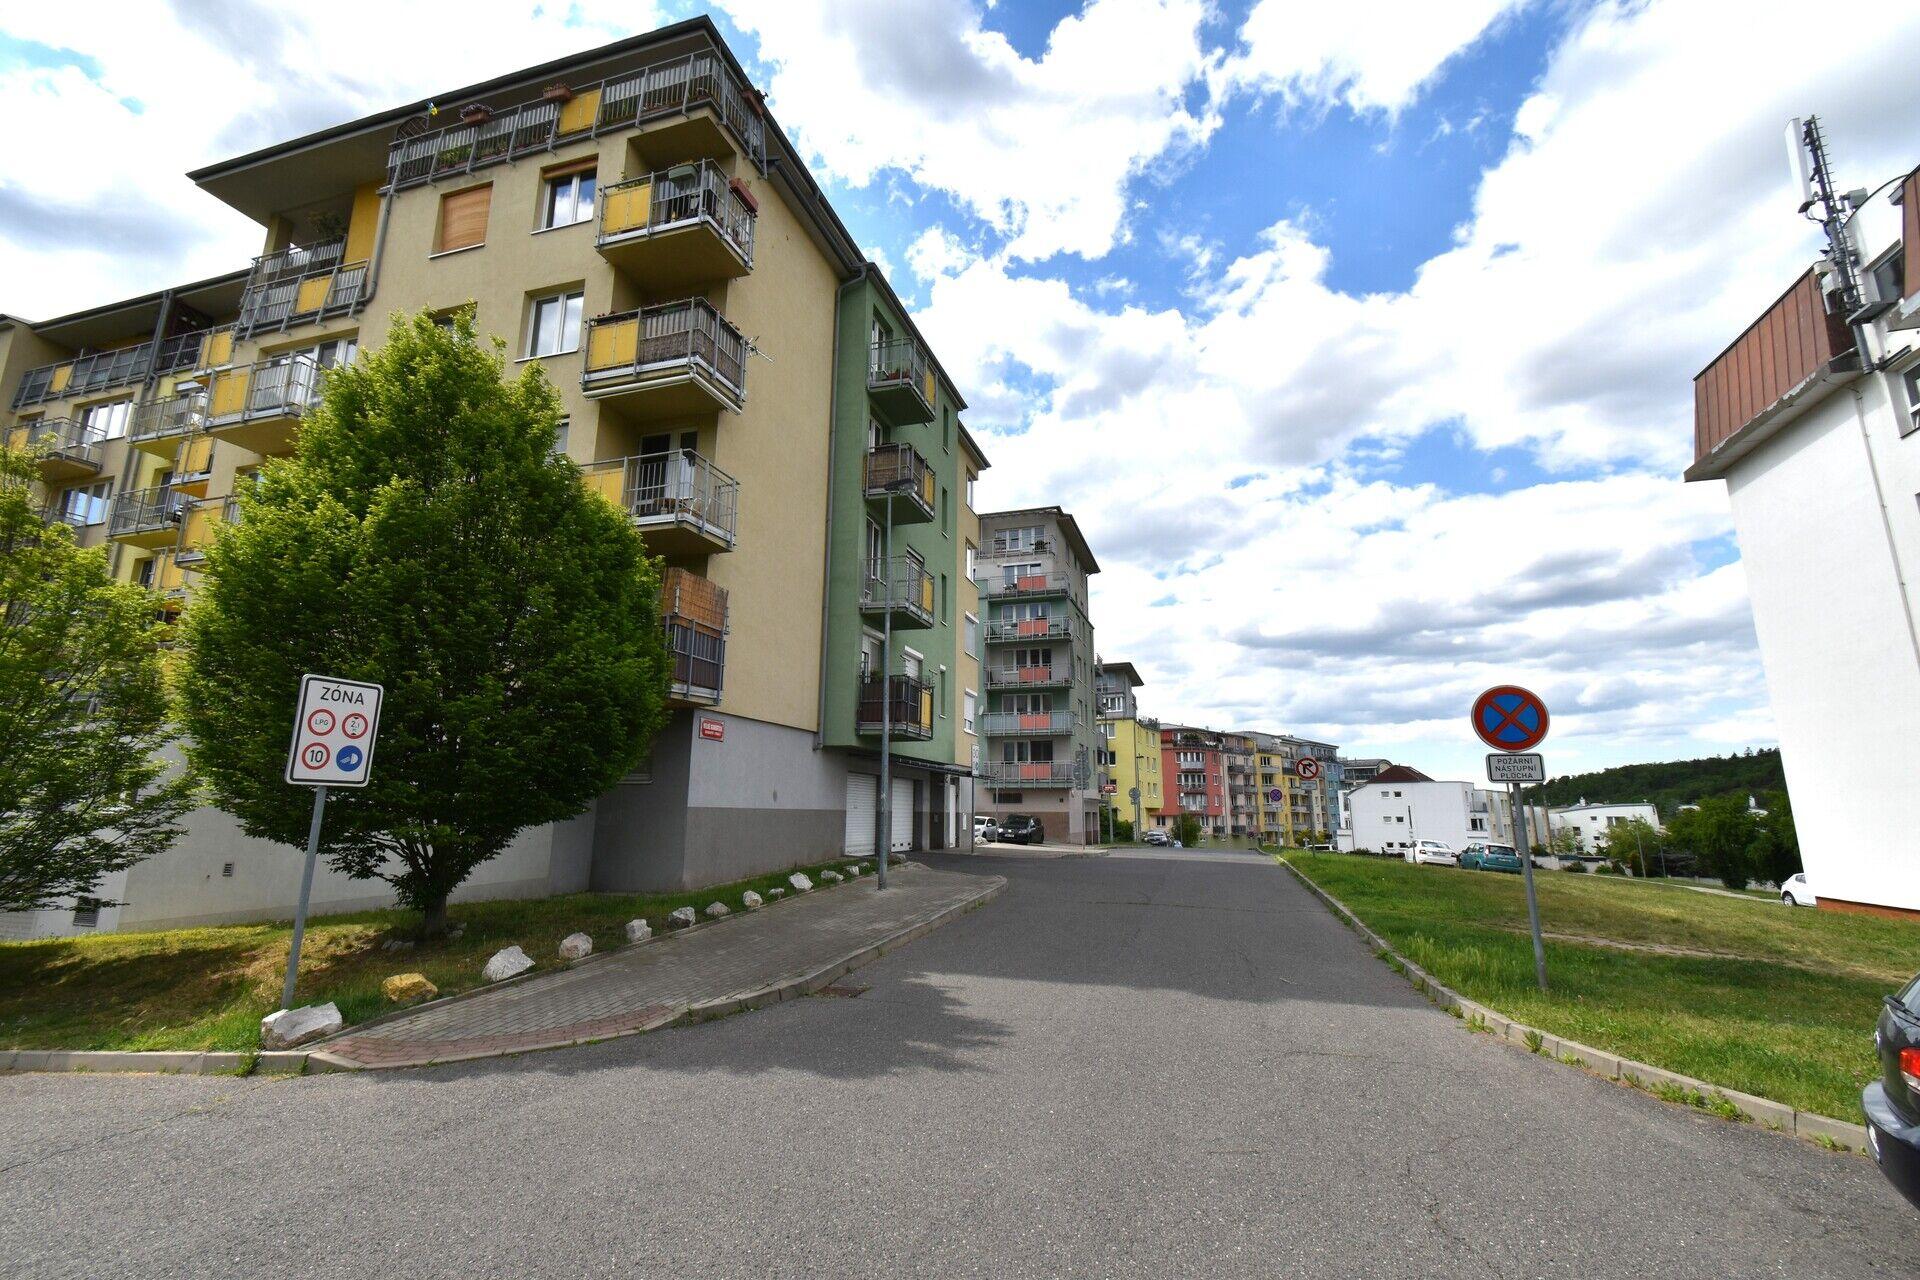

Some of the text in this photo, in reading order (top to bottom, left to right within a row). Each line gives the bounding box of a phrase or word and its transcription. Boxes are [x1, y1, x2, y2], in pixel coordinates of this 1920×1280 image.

[320, 684, 364, 705] ZÓNA
[310, 749, 324, 763] 10
[1497, 757, 1533, 765] POŽÁRNÍ
